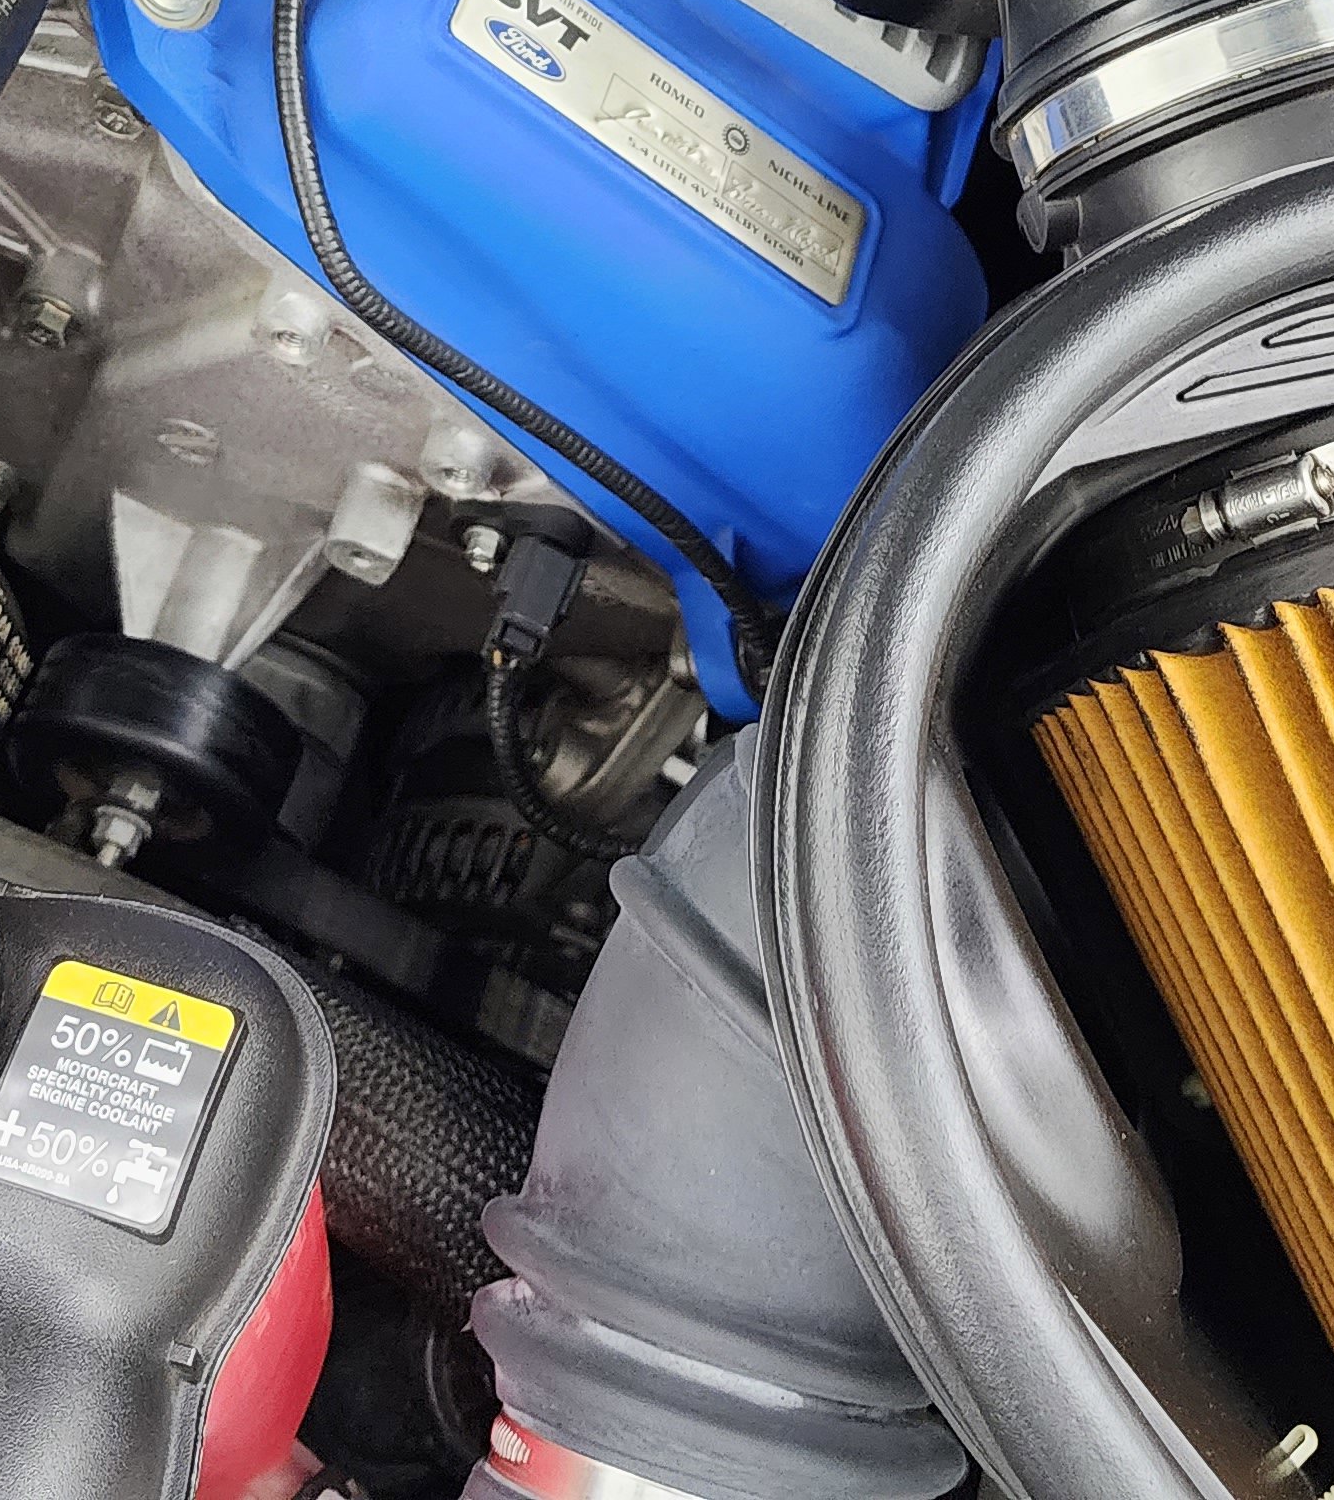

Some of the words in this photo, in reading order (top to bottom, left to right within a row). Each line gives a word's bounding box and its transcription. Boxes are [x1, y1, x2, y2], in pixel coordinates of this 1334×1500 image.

[576, 5, 604, 32] PRIDE
[493, 22, 559, 75] Ford
[649, 72, 706, 119] ROMEO
[50, 1014, 134, 1068] 50%
[27, 1064, 109, 1102] SPECIALTY
[108, 1087, 176, 1125] ORANGE
[55, 1056, 160, 1100] MOTORCRAFT
[28, 1082, 87, 1113] ENGINE
[87, 1100, 163, 1137] COOLANT
[26, 1121, 109, 1178] 50%
